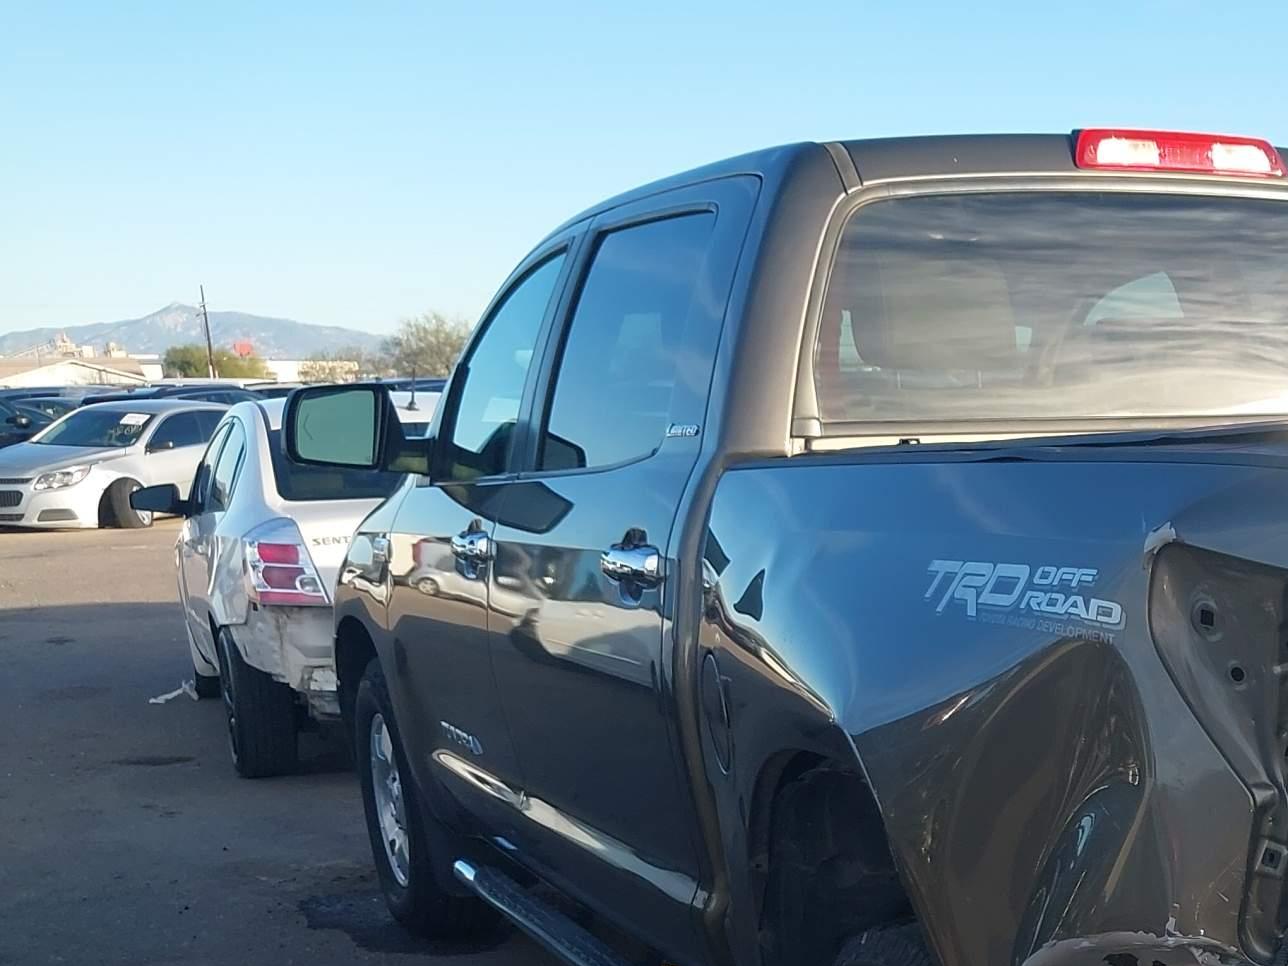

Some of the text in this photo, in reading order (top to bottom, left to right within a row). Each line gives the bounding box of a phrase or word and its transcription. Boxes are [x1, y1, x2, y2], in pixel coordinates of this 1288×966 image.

[924, 560, 1099, 618] TRD OFF
[1019, 591, 1125, 629] ROAD
